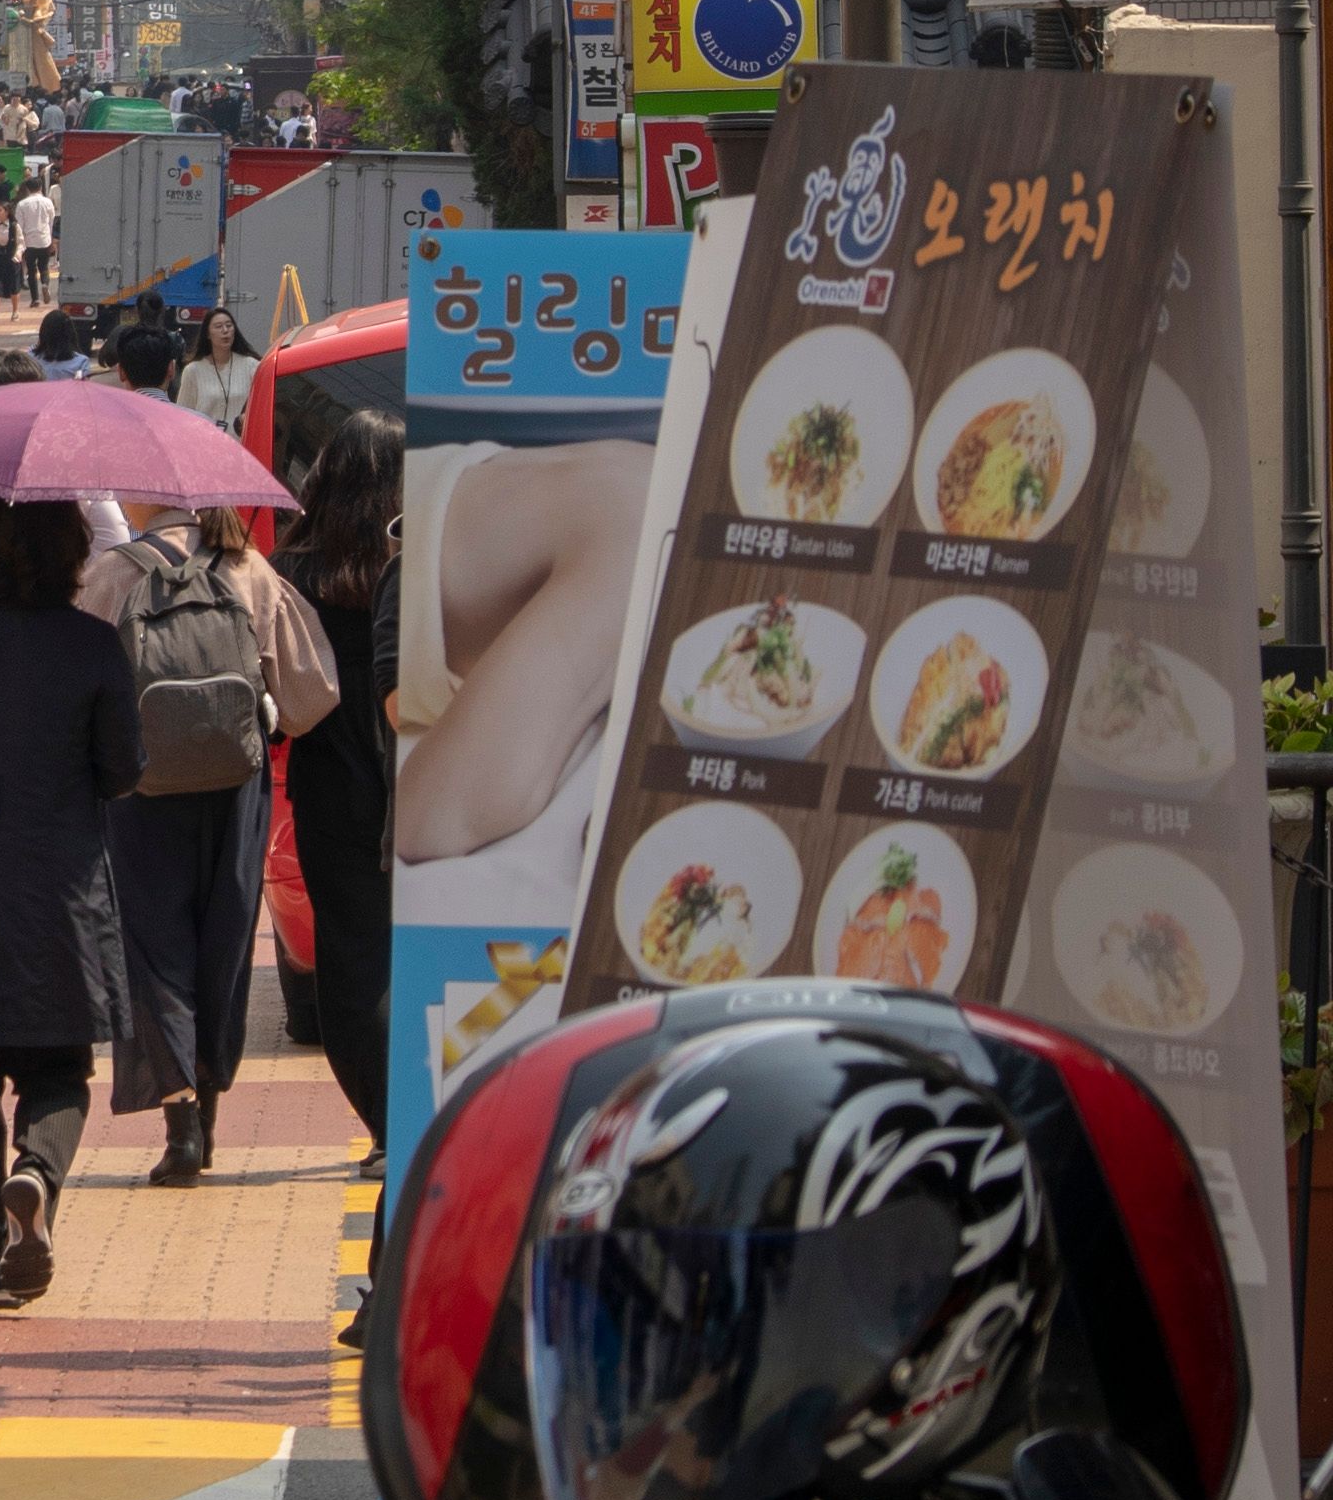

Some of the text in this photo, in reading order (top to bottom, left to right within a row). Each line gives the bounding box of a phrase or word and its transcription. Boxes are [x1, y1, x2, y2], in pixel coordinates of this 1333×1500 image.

[699, 29, 798, 74] BILLIARD CLUB
[167, 165, 183, 182] CJ
[403, 208, 427, 228] CJ
[799, 276, 862, 303] Orenchi
[724, 522, 789, 561] 탄탄우동
